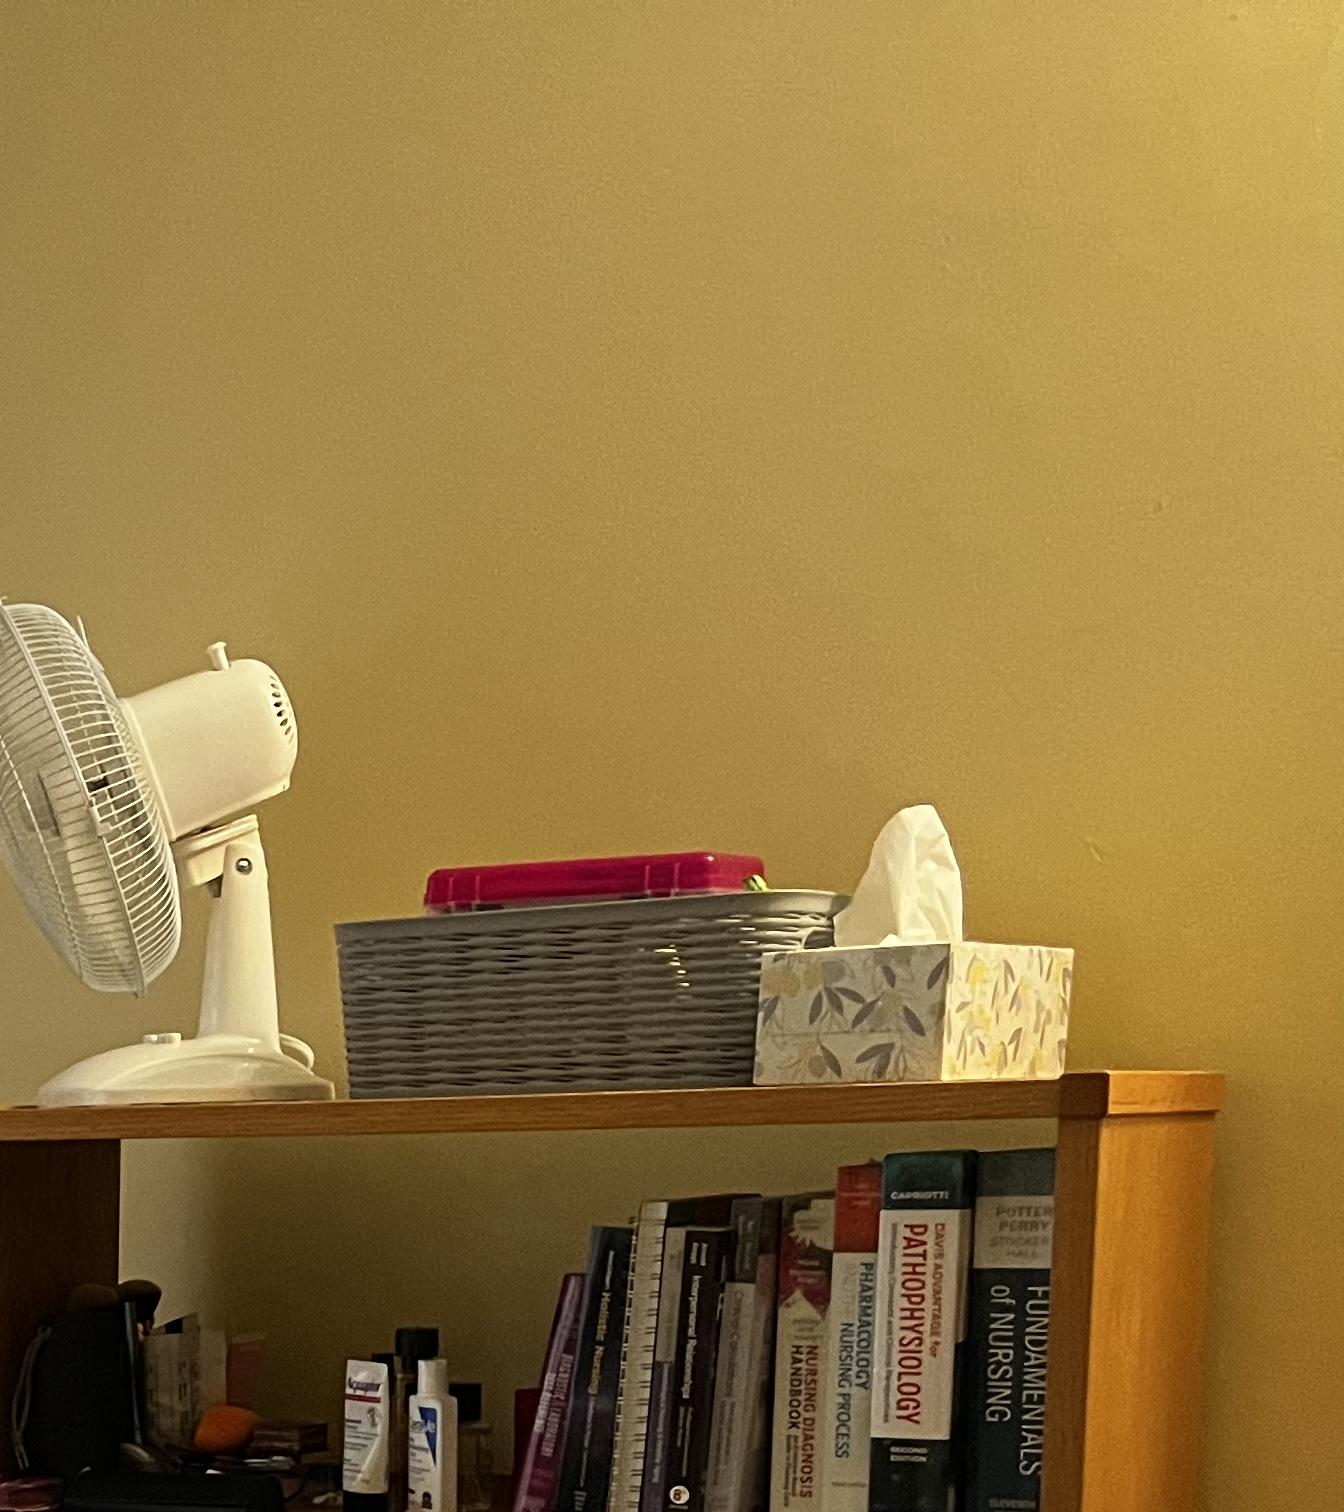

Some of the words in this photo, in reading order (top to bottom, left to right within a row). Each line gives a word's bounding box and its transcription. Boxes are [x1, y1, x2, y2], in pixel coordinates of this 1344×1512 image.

[934, 1223, 945, 1260] DAVIS
[596, 1292, 611, 1341] Holistic
[855, 1262, 874, 1391] PHARMACOLOGY
[895, 1224, 928, 1425] PATHOPHYSIOLOGY
[930, 1263, 943, 1338] ADVANTAGE
[991, 1285, 1015, 1305] of
[587, 1345, 605, 1395] Nursing
[802, 1344, 819, 1413] NURSING
[838, 1323, 854, 1388] NURSING
[929, 1341, 940, 1358] for
[985, 1312, 1014, 1423] NURSING
[1018, 1284, 1050, 1477] FUNDAMENTALS
[787, 1344, 803, 1430] HANDBOOK
[800, 1417, 815, 1499] DIAGNOSIS
[835, 1393, 851, 1459] PROCESS
